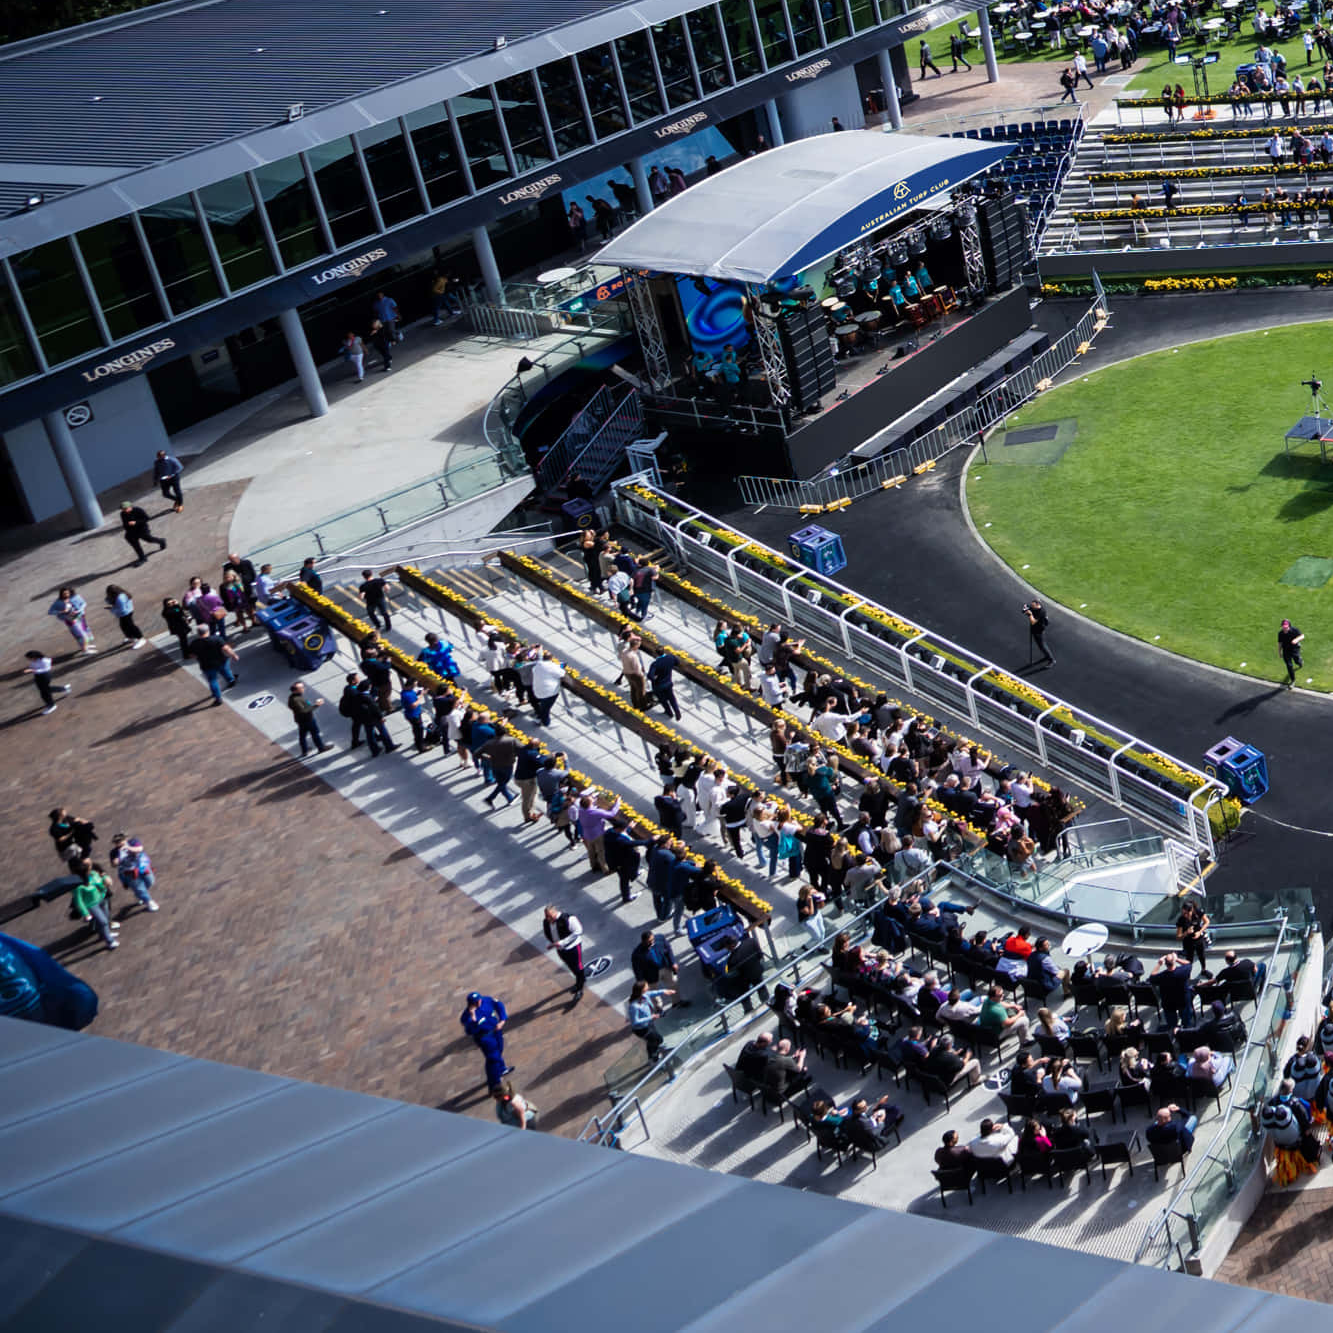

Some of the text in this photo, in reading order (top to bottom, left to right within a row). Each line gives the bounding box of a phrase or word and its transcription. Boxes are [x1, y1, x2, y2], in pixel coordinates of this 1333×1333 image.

[785, 58, 831, 82] LONGINES
[654, 111, 708, 138] LONGINES
[498, 173, 562, 205] LONGINES
[861, 178, 949, 232] AUSTRALIAN TURF CLUB
[311, 248, 388, 285] LONGINES
[81, 337, 176, 383] LONGINES
